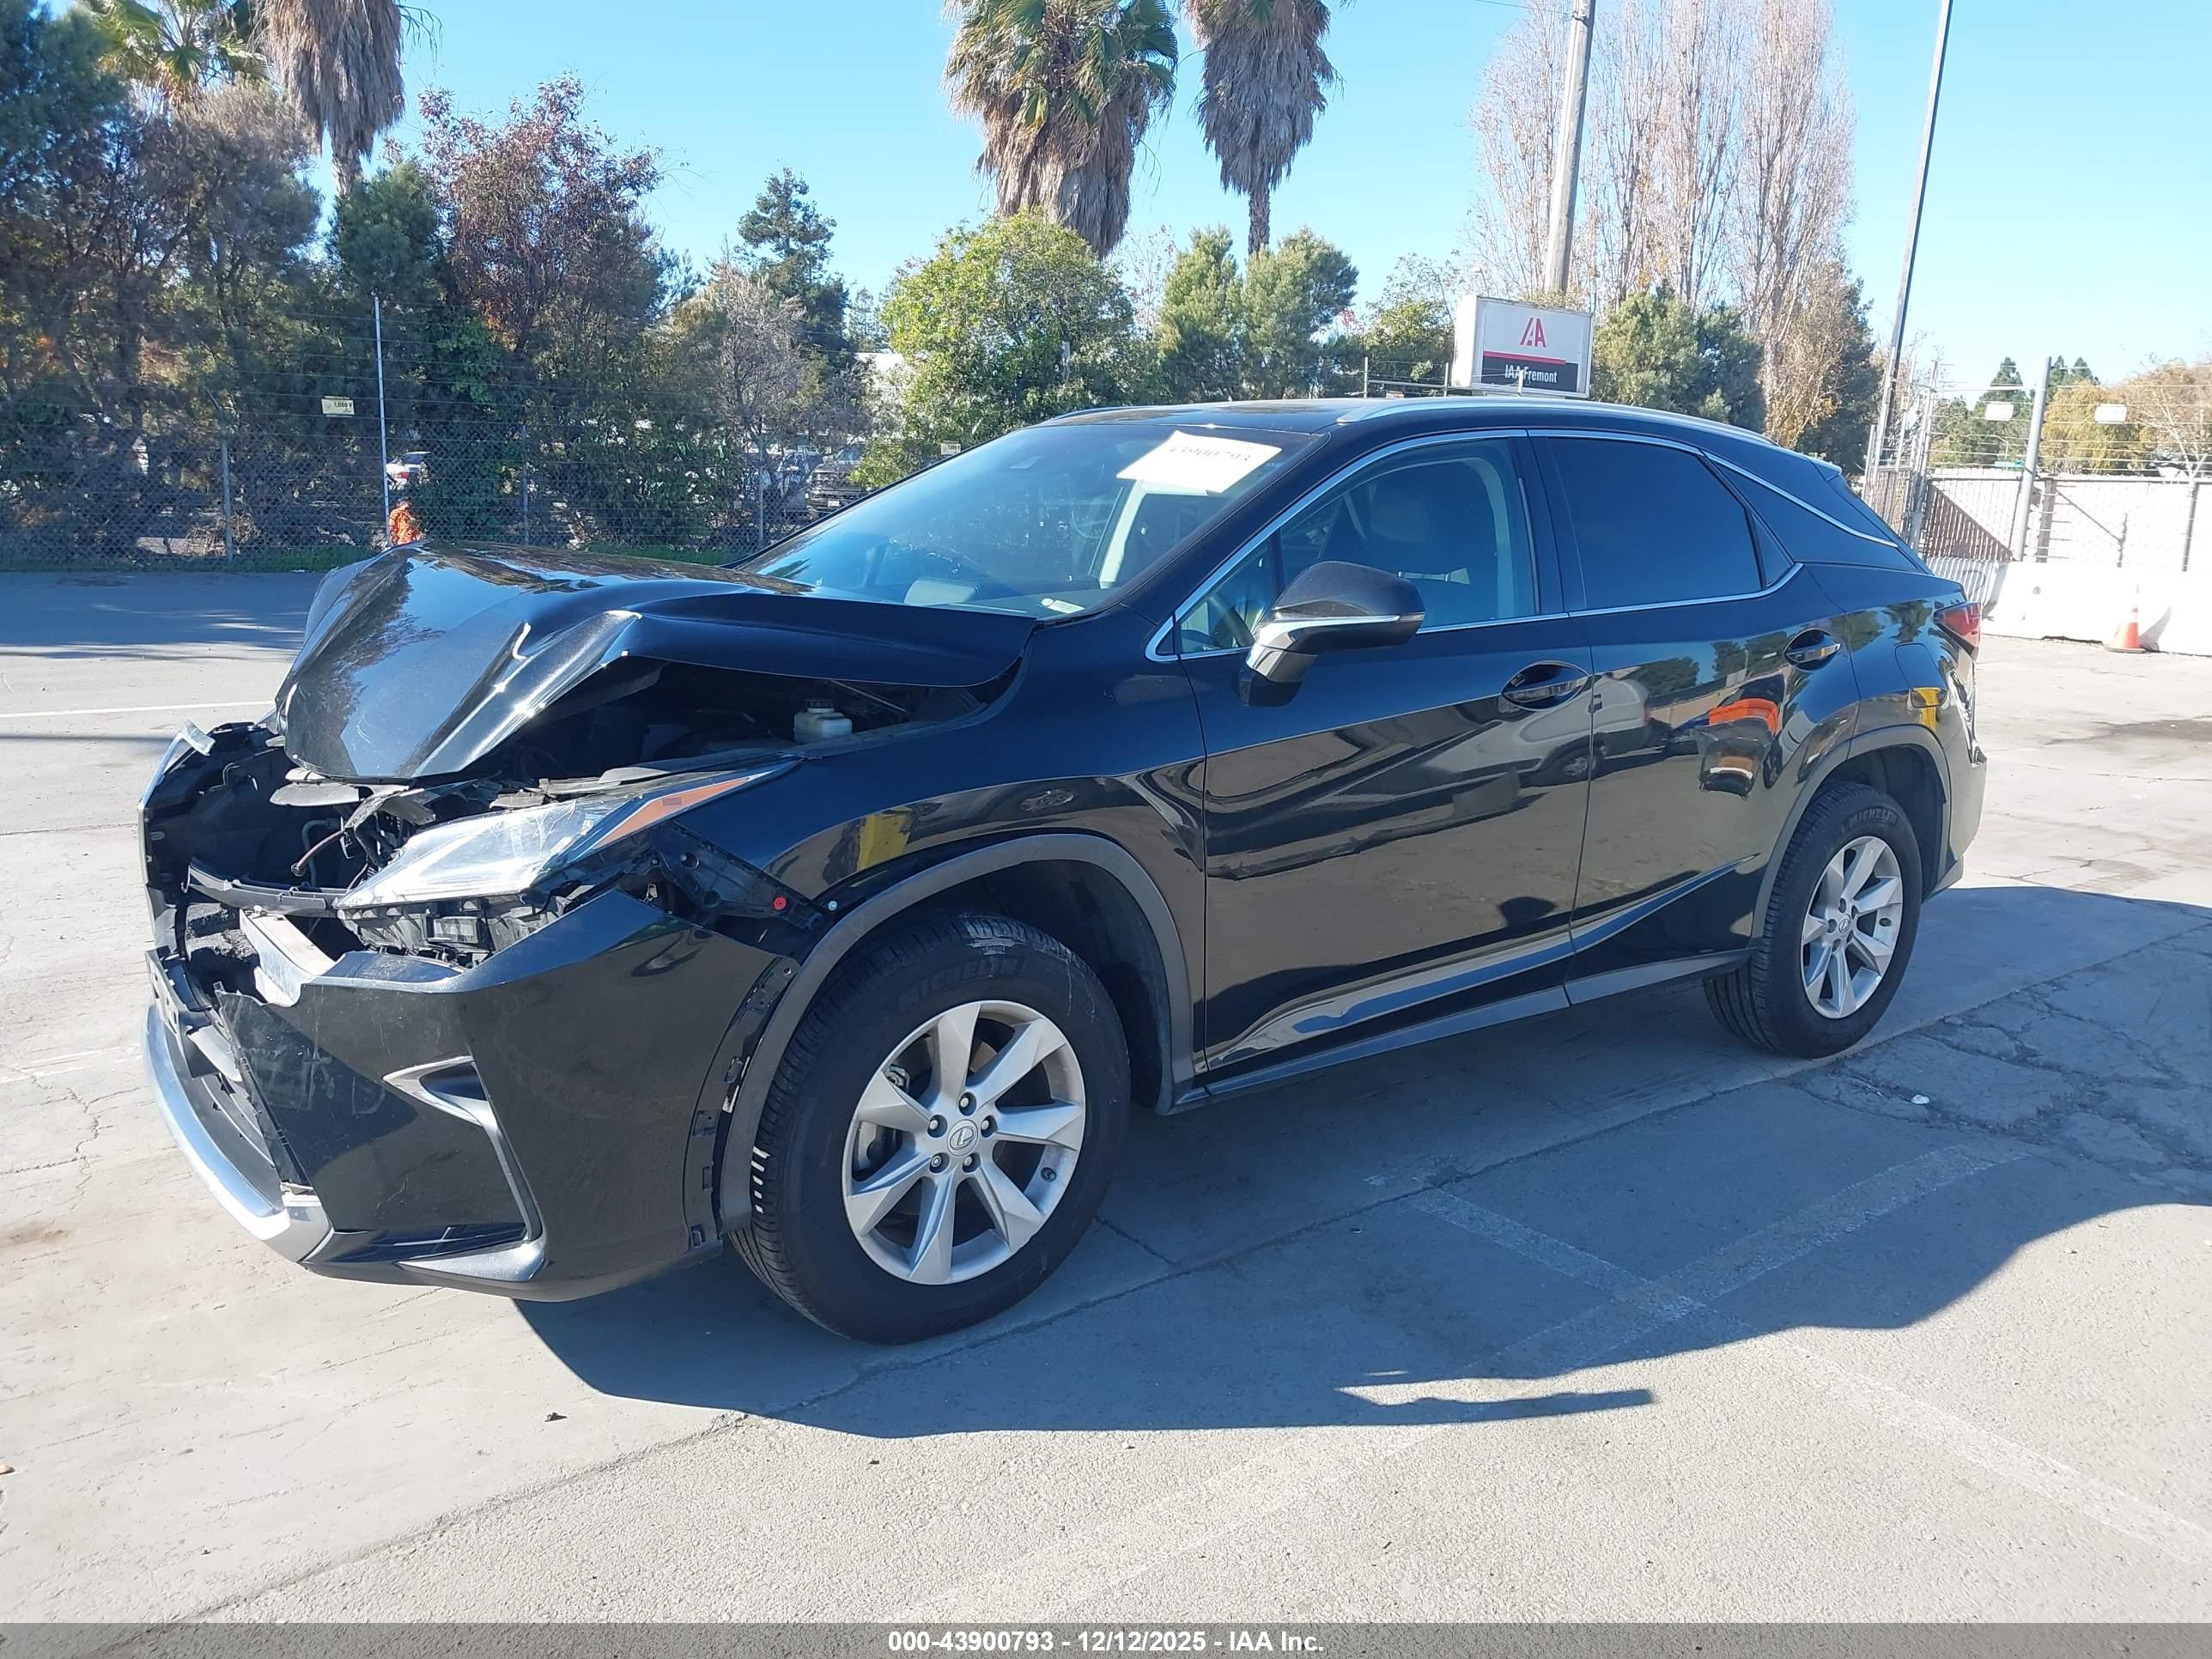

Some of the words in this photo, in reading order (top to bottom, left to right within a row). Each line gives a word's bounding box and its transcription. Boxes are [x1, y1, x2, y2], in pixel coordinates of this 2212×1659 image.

[1504, 364, 1522, 379] IAA
[1523, 367, 1558, 383] Fremont
[899, 957, 1021, 1012] MICHELIN
